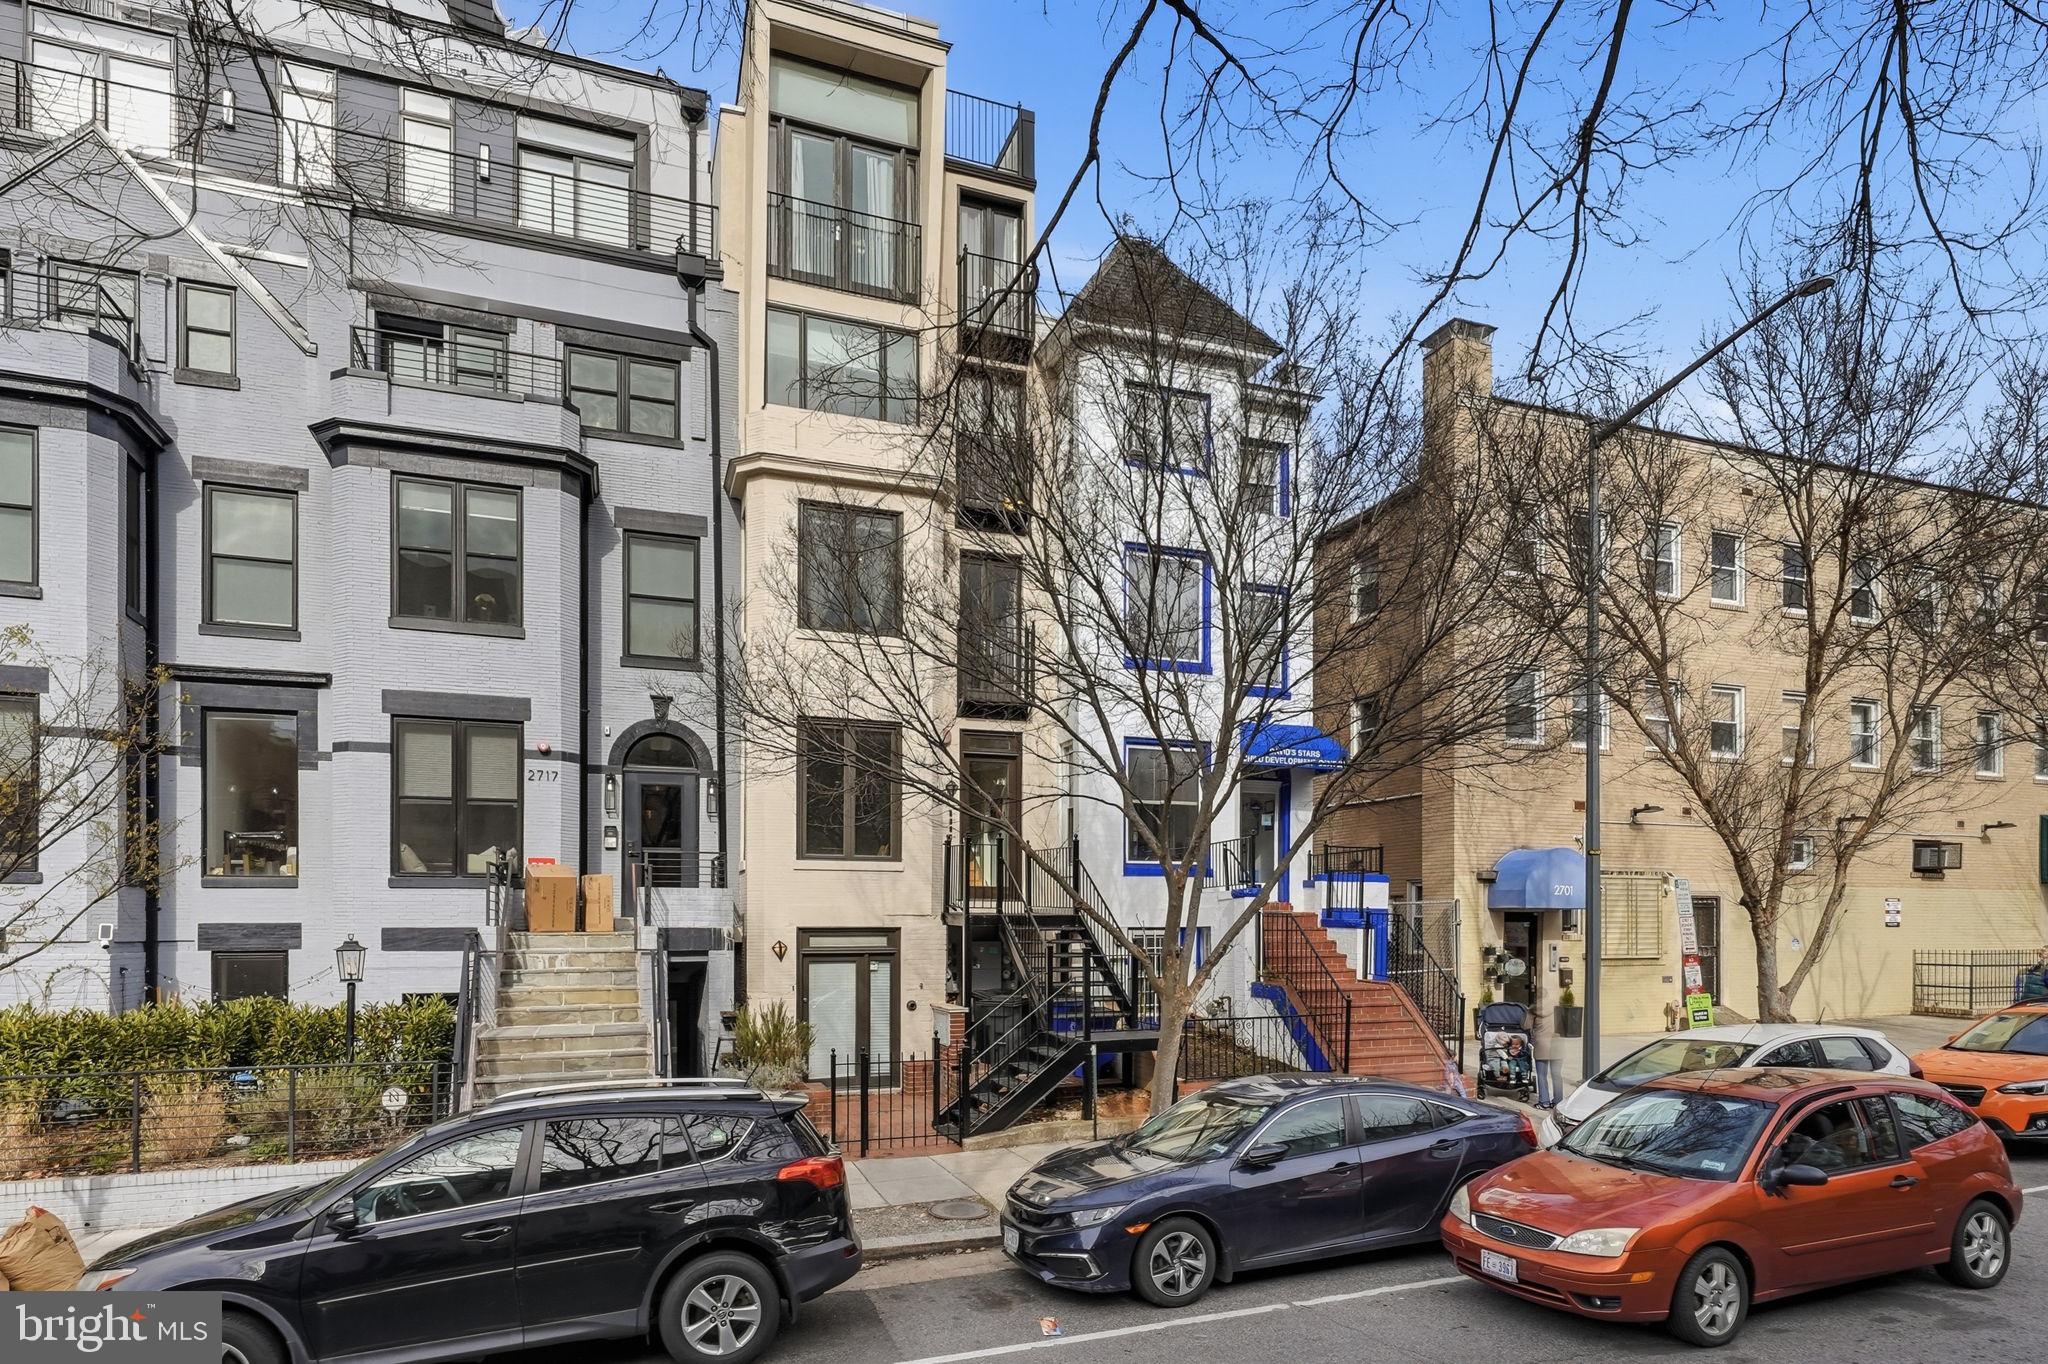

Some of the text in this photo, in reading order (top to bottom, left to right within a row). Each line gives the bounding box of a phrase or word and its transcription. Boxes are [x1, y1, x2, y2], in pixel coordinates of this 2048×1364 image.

[1297, 749, 1321, 758] STARS
[528, 769, 558, 782] 2717
[1554, 884, 1573, 896] 2701
